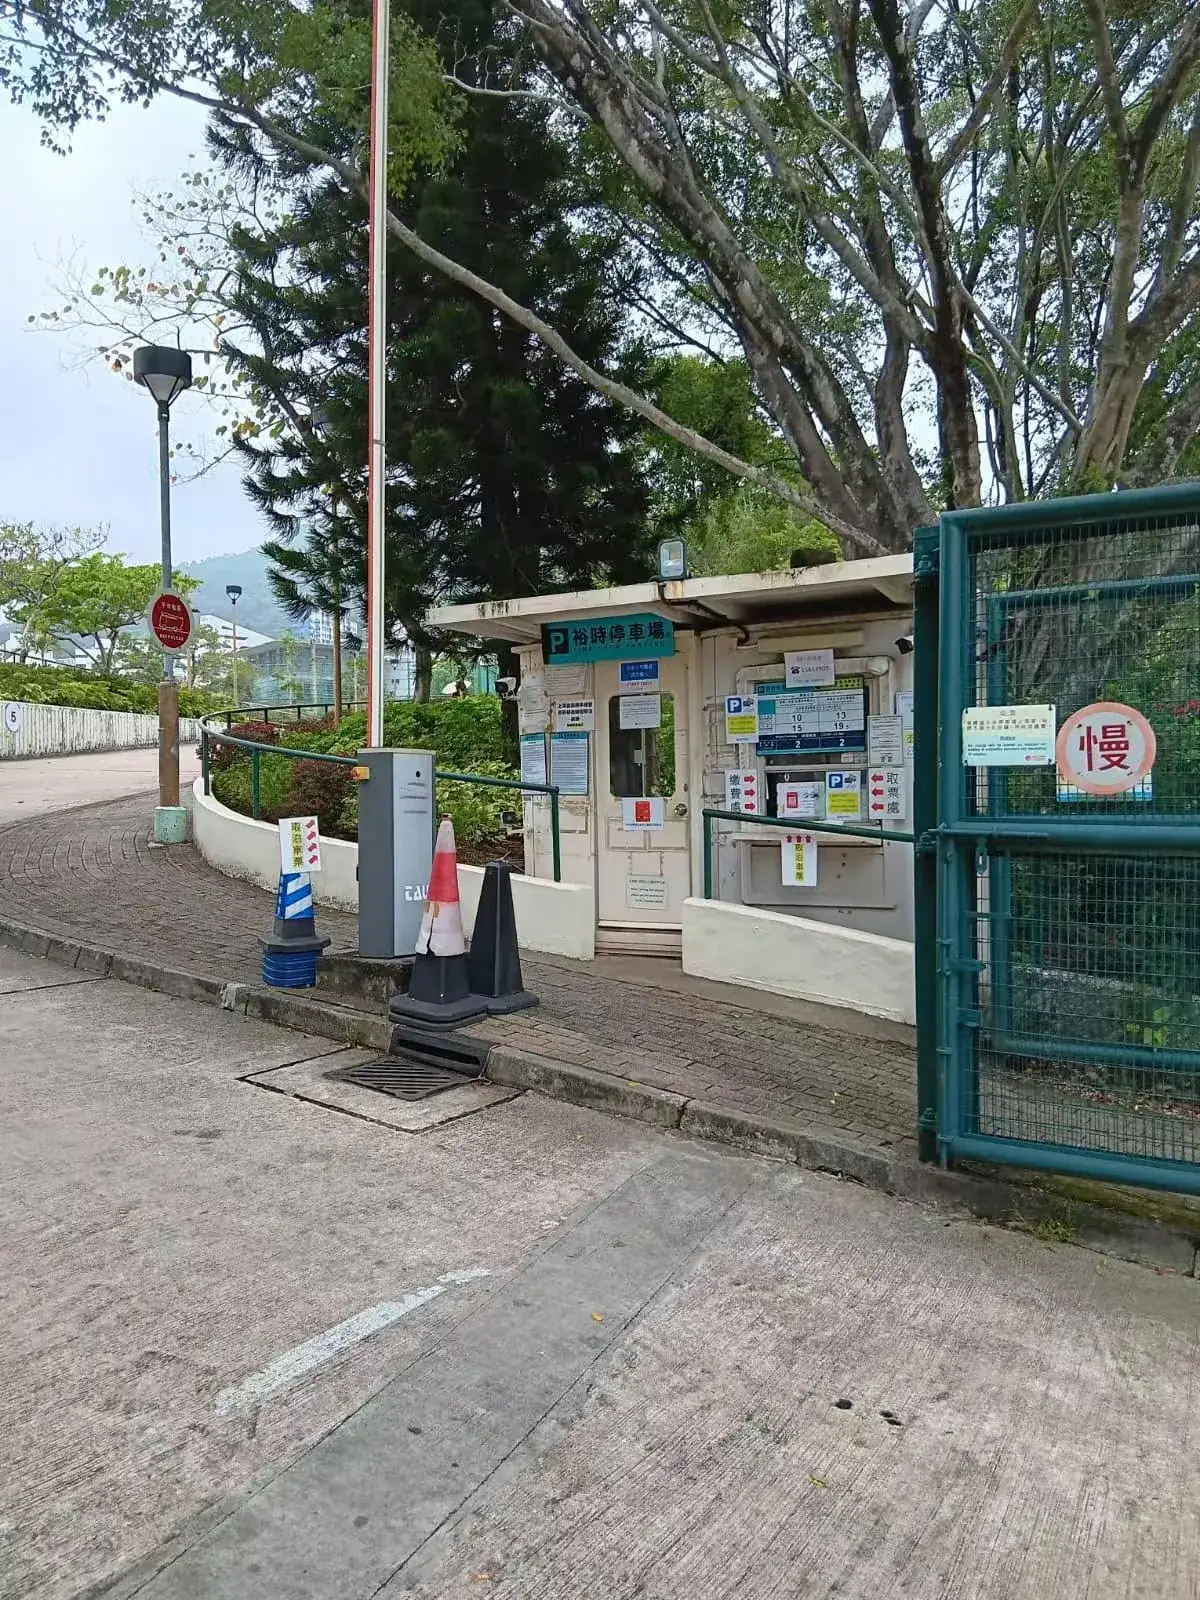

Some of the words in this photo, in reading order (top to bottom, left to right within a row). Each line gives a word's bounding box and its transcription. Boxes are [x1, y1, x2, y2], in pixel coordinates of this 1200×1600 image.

[550, 632, 564, 653] P
[572, 621, 665, 647] 裕時停車場
[792, 714, 802, 722] 10
[836, 711, 847, 719] 13
[792, 724, 803, 732] 15
[795, 740, 801, 748] 2
[839, 738, 846, 746] 2
[1078, 724, 1130, 772] 慢
[886, 772, 900, 814] 取票處
